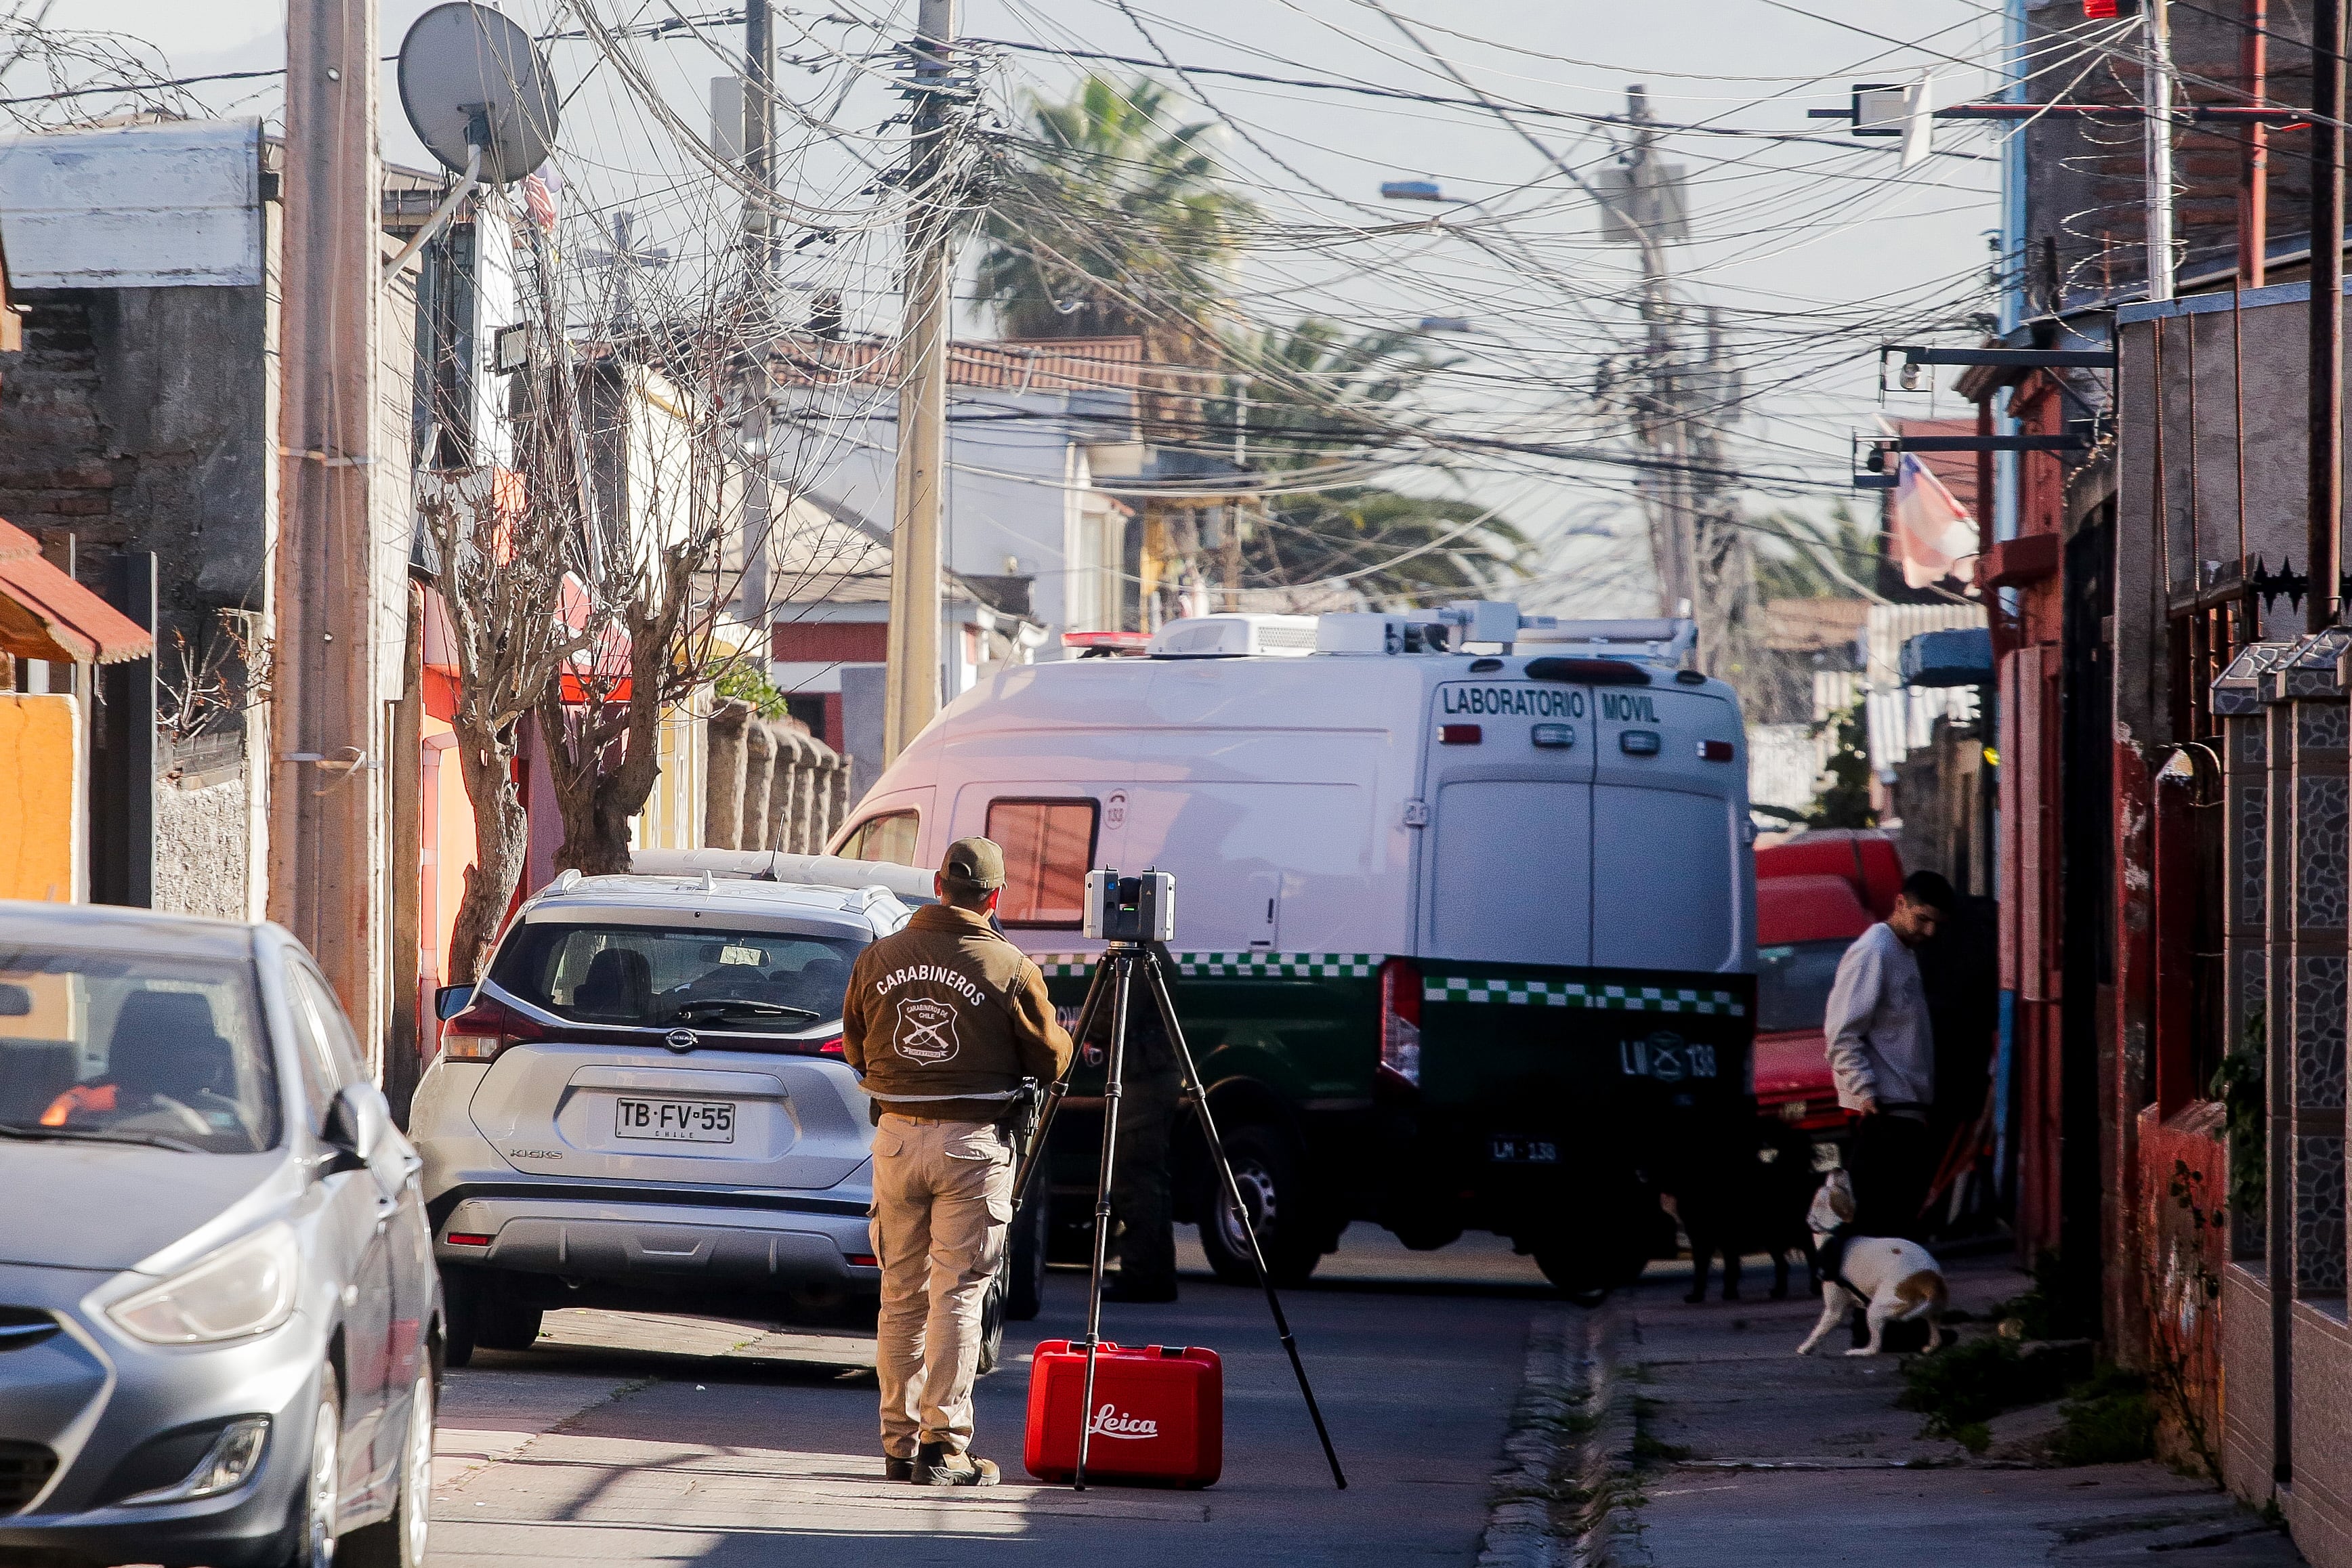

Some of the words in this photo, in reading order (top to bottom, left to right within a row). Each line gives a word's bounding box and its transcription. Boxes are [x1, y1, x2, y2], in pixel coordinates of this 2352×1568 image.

[1443, 687, 1584, 718] LABORATORIO
[1601, 693, 1661, 723] MOVIL
[876, 965, 986, 1007] CARABINEROS
[906, 1004, 941, 1014] CARABINEROS
[655, 1130, 694, 1139] CHILE
[510, 1149, 562, 1160] KICKS
[1089, 1403, 1158, 1439] Leica
